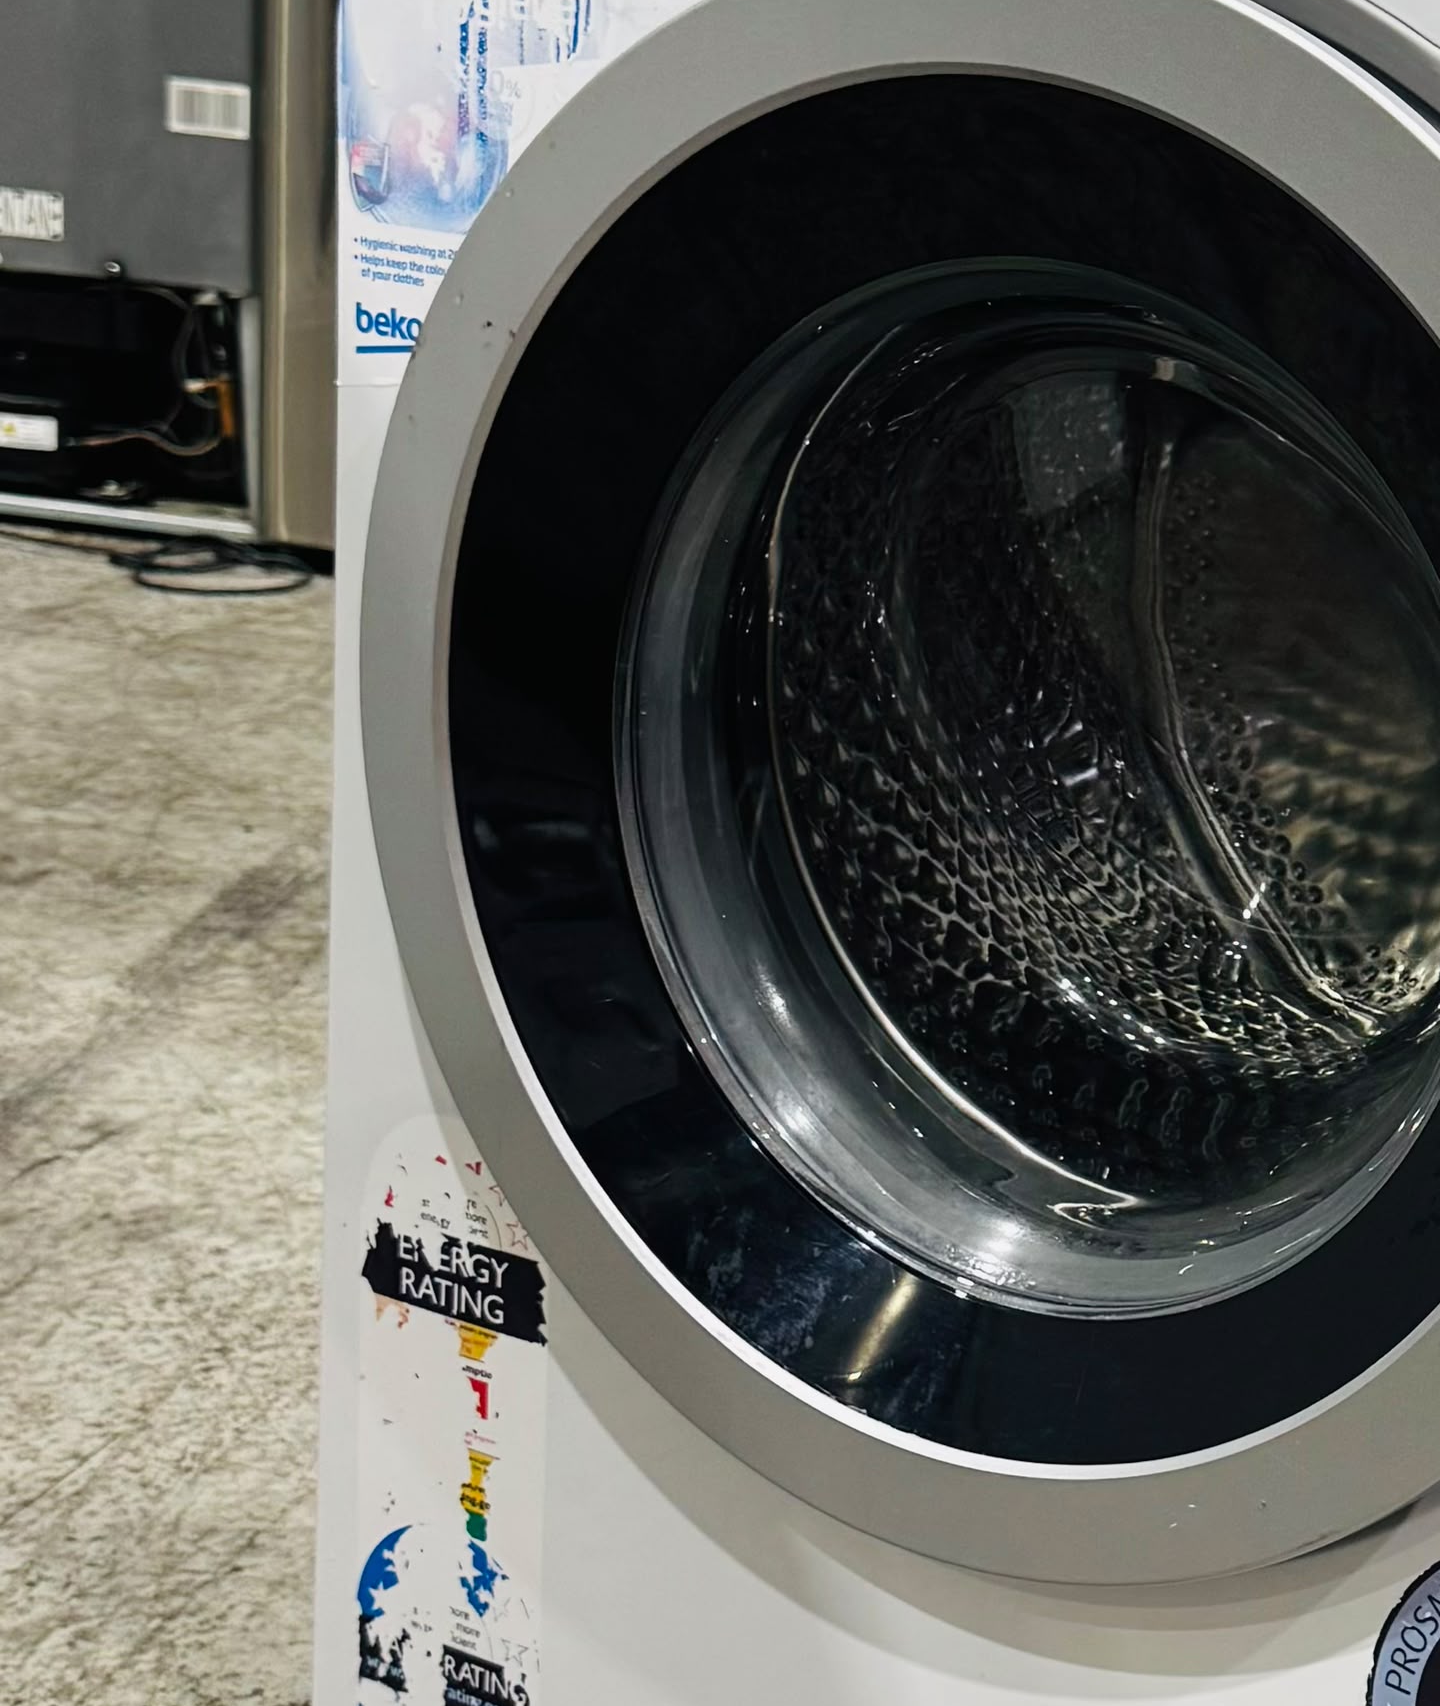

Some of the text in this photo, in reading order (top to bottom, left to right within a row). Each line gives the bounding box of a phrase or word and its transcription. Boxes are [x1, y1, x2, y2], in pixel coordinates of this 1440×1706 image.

[360, 236, 398, 252] Hygienic
[399, 243, 436, 260] washing
[437, 249, 447, 260] at
[360, 253, 448, 277] Helps keep the colo
[361, 267, 425, 287] of your clothes
[355, 301, 423, 344] beko
[400, 1266, 506, 1325] RATING
